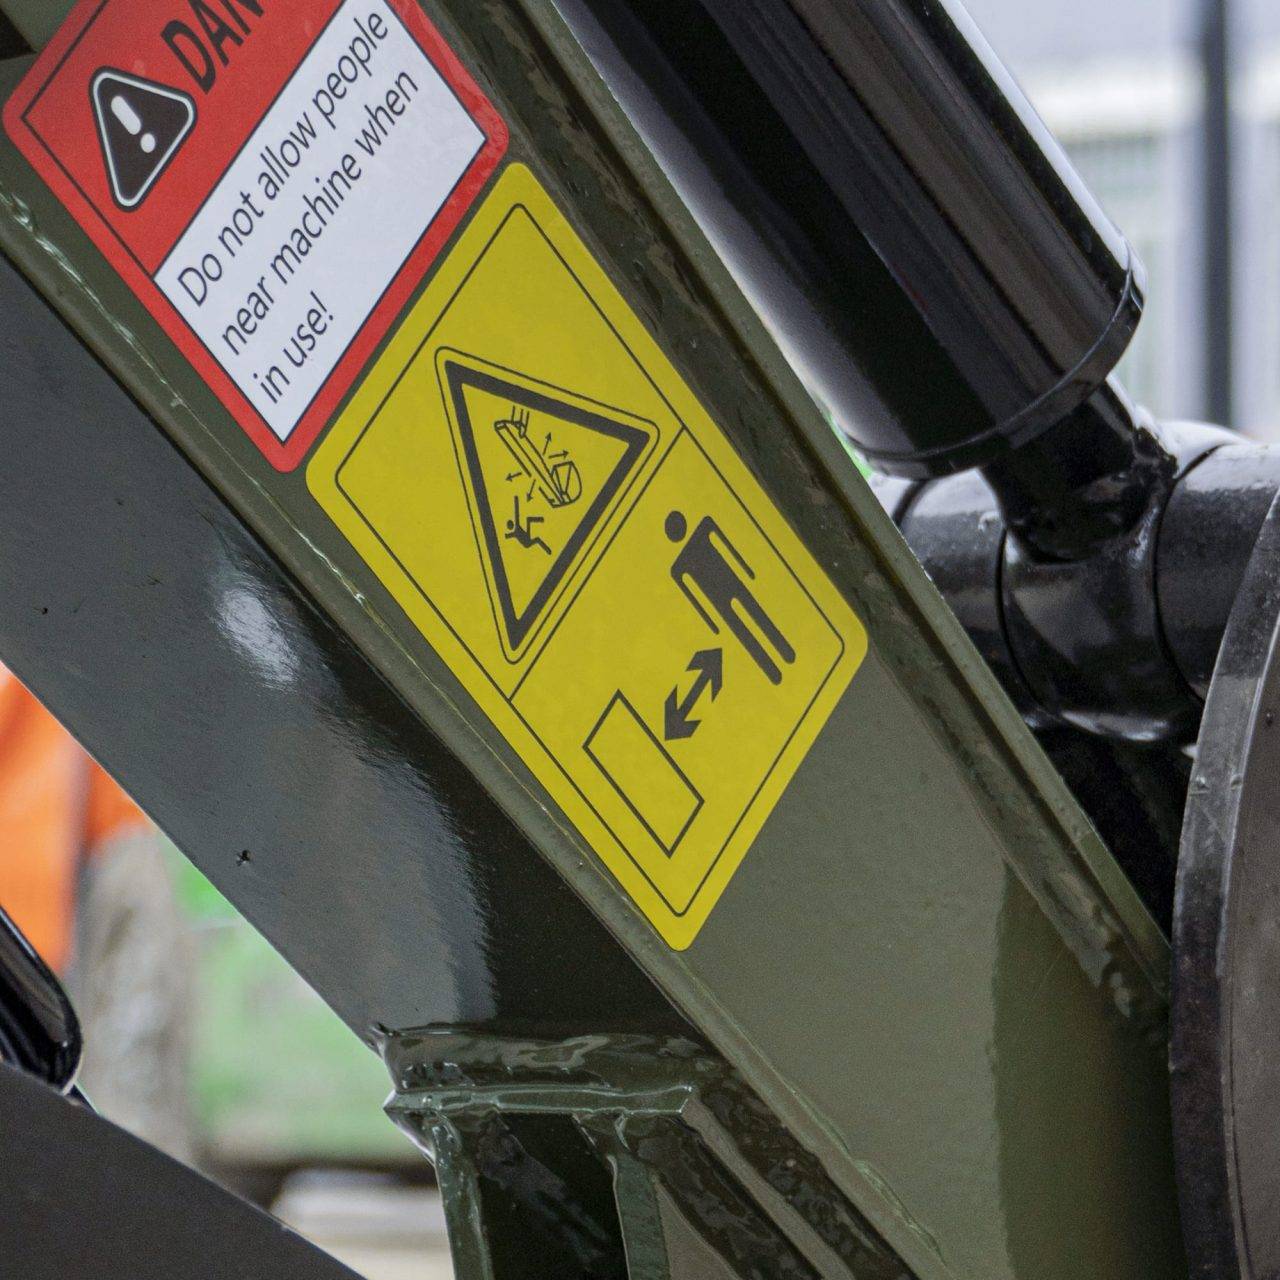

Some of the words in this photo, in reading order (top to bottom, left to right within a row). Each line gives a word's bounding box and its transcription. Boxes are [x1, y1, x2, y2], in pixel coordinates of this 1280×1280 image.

[177, 253, 224, 308] Do
[217, 191, 266, 259] not
[257, 111, 318, 202] allow
[311, 12, 390, 131] people
[221, 276, 276, 357] near
[270, 153, 363, 286] machine
[354, 71, 420, 158] when
[253, 365, 292, 405] in
[282, 290, 335, 369] use!
